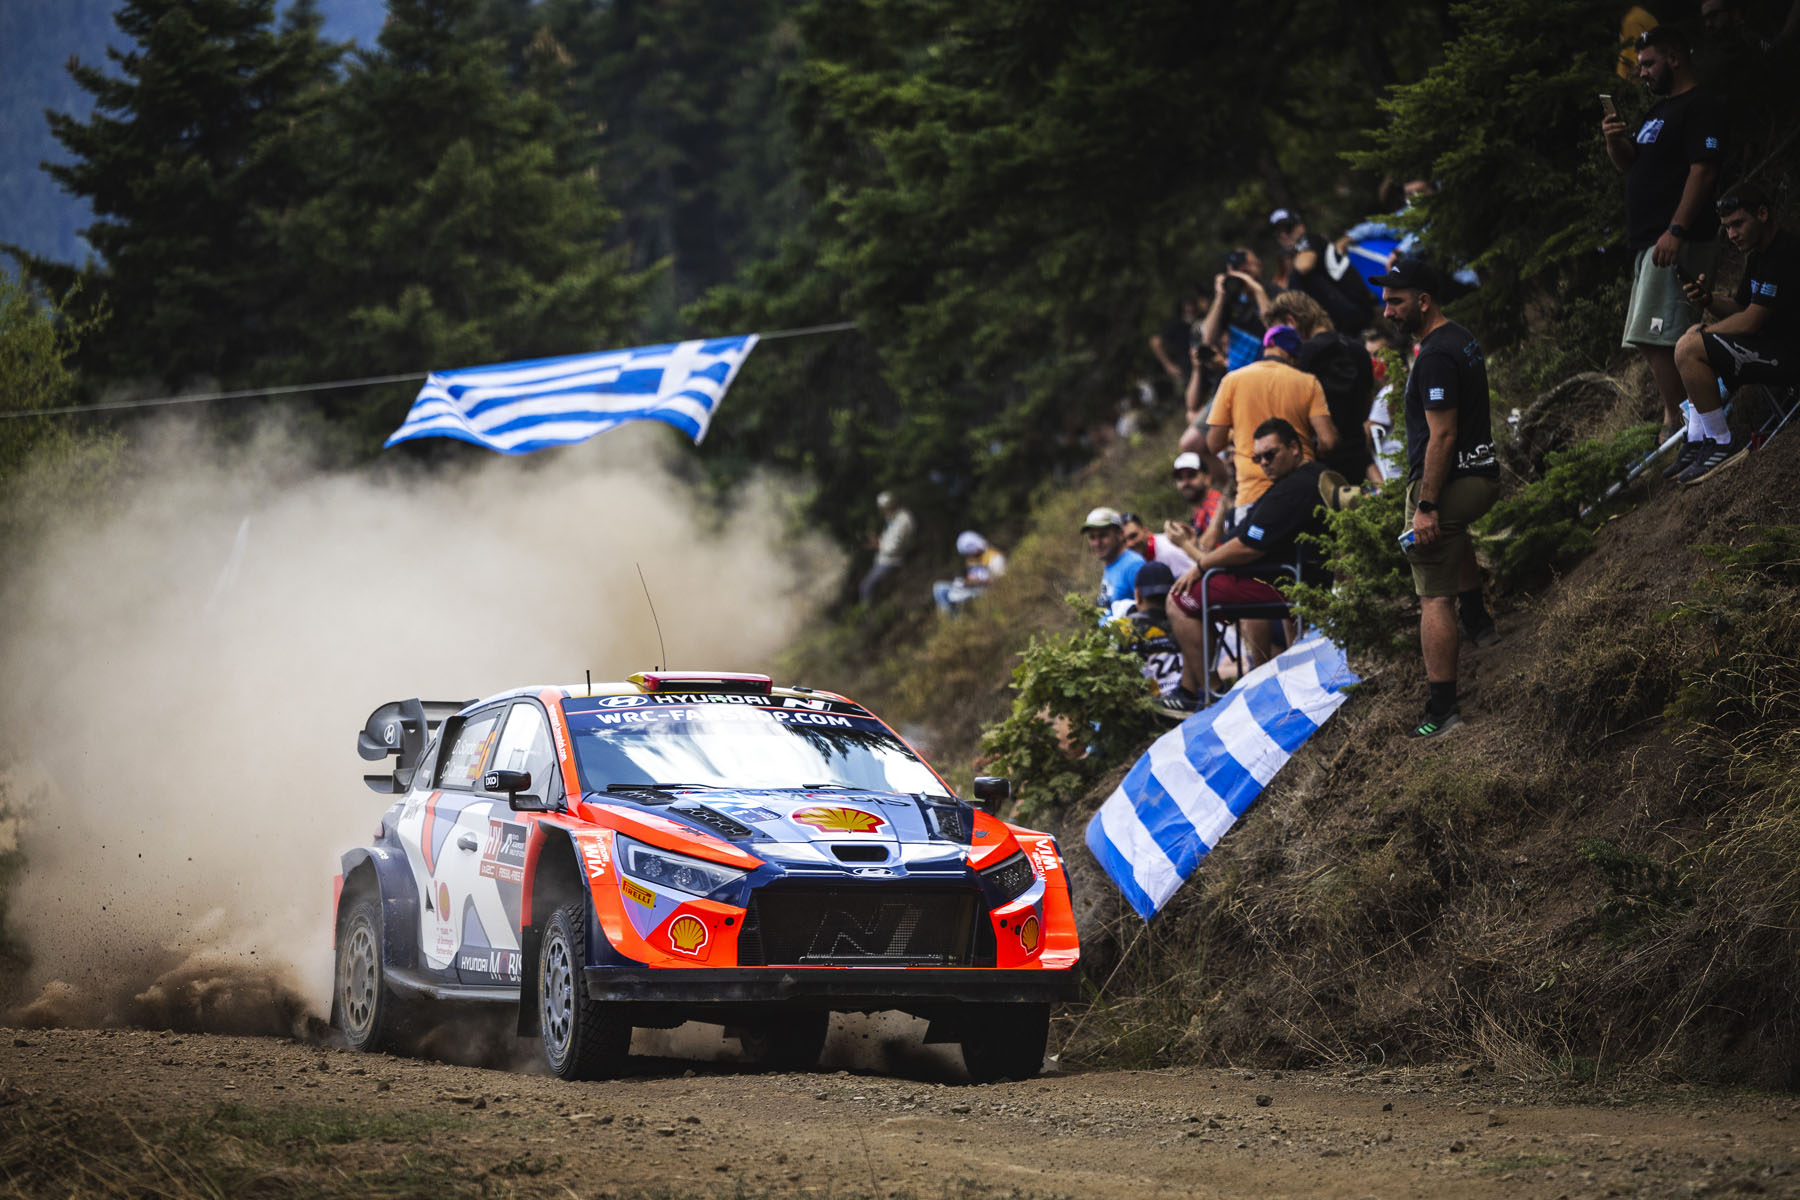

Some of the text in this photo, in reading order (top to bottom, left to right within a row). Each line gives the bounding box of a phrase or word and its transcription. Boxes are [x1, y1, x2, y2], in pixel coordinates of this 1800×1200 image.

[654, 694, 772, 705] HYUNDAI
[622, 880, 652, 904] PIRELLI
[461, 956, 488, 972] HYUNDAI
